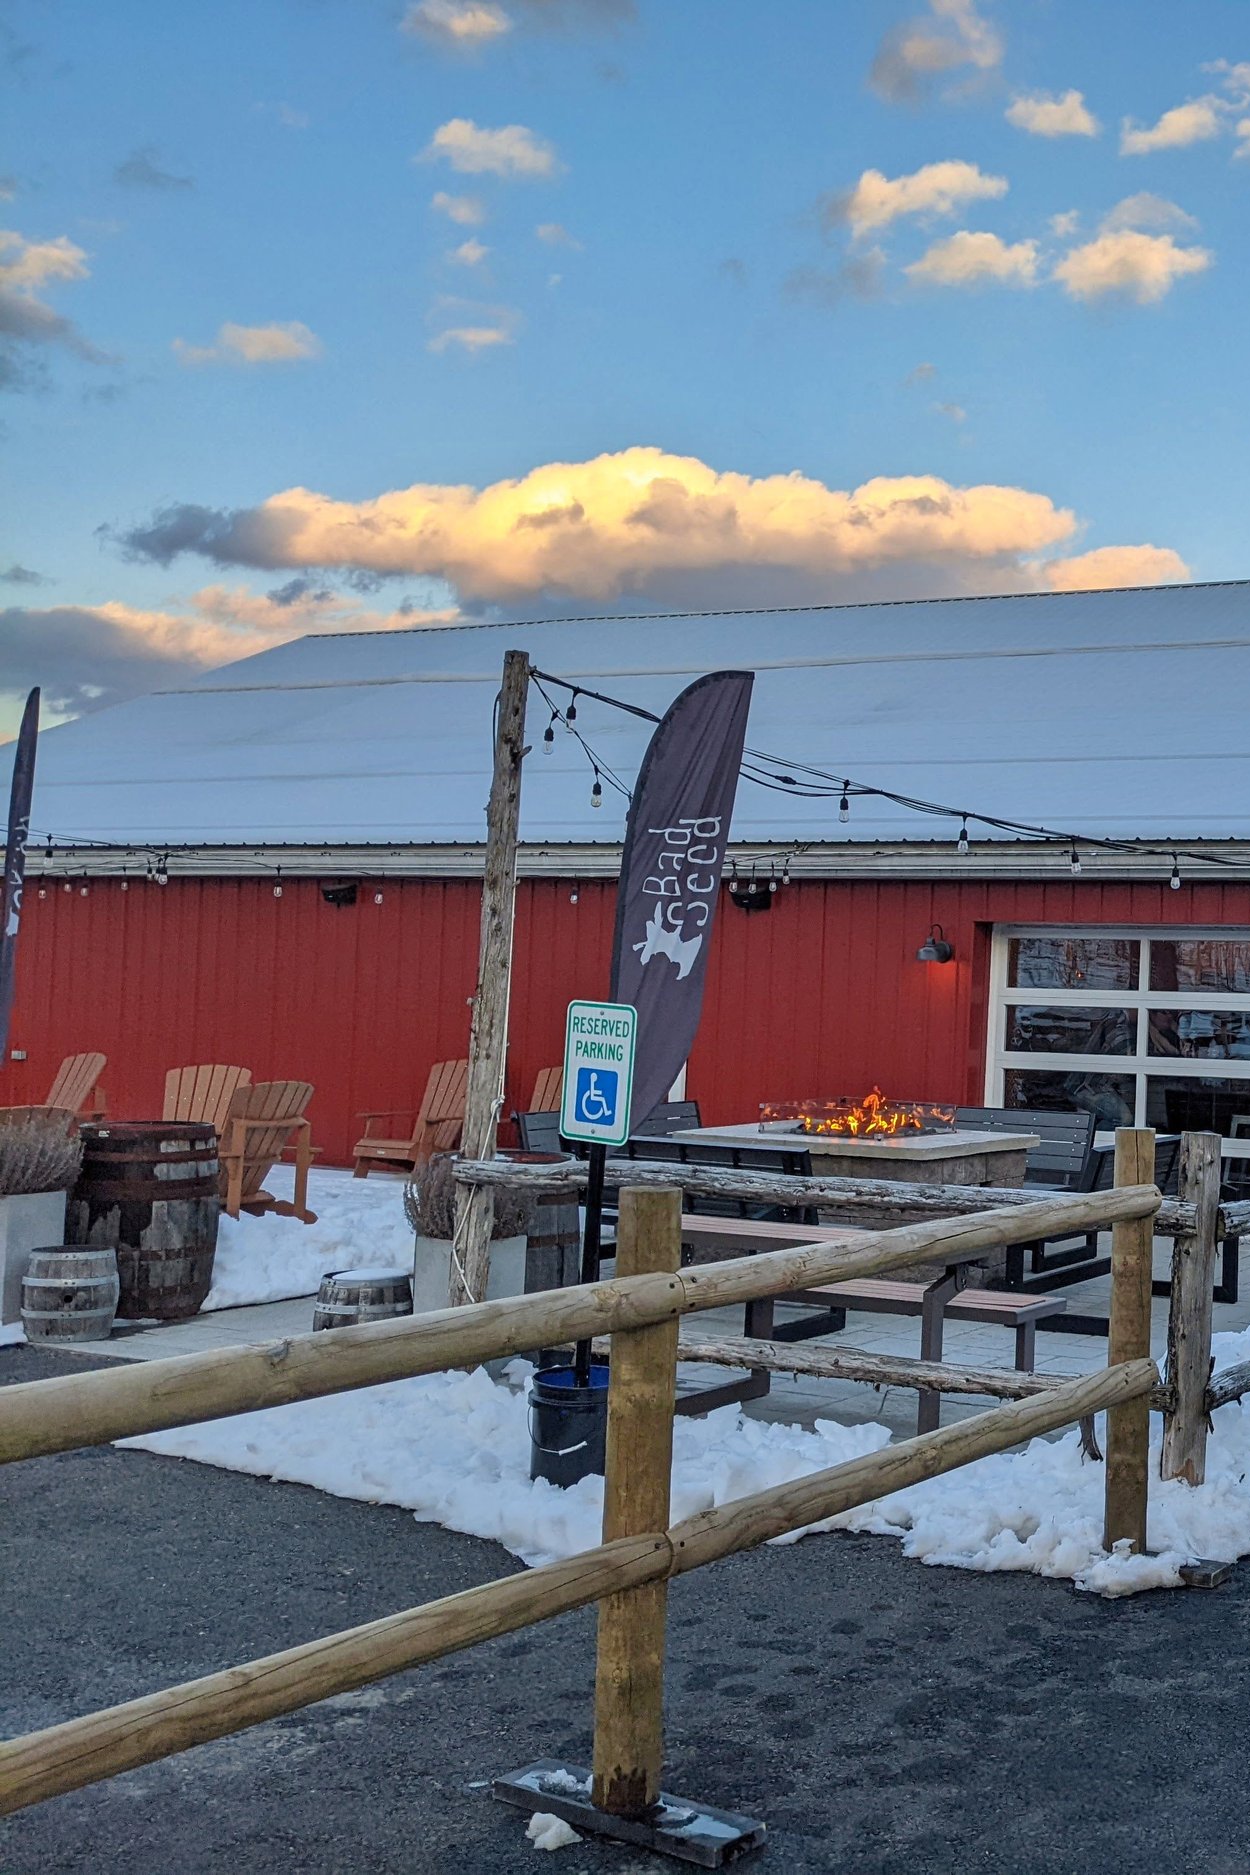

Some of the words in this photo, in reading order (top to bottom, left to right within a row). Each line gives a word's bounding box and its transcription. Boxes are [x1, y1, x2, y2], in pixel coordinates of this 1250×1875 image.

[642, 827, 692, 897] Bad
[572, 1016, 630, 1038] RESERVED
[575, 1040, 624, 1062] PARKING
